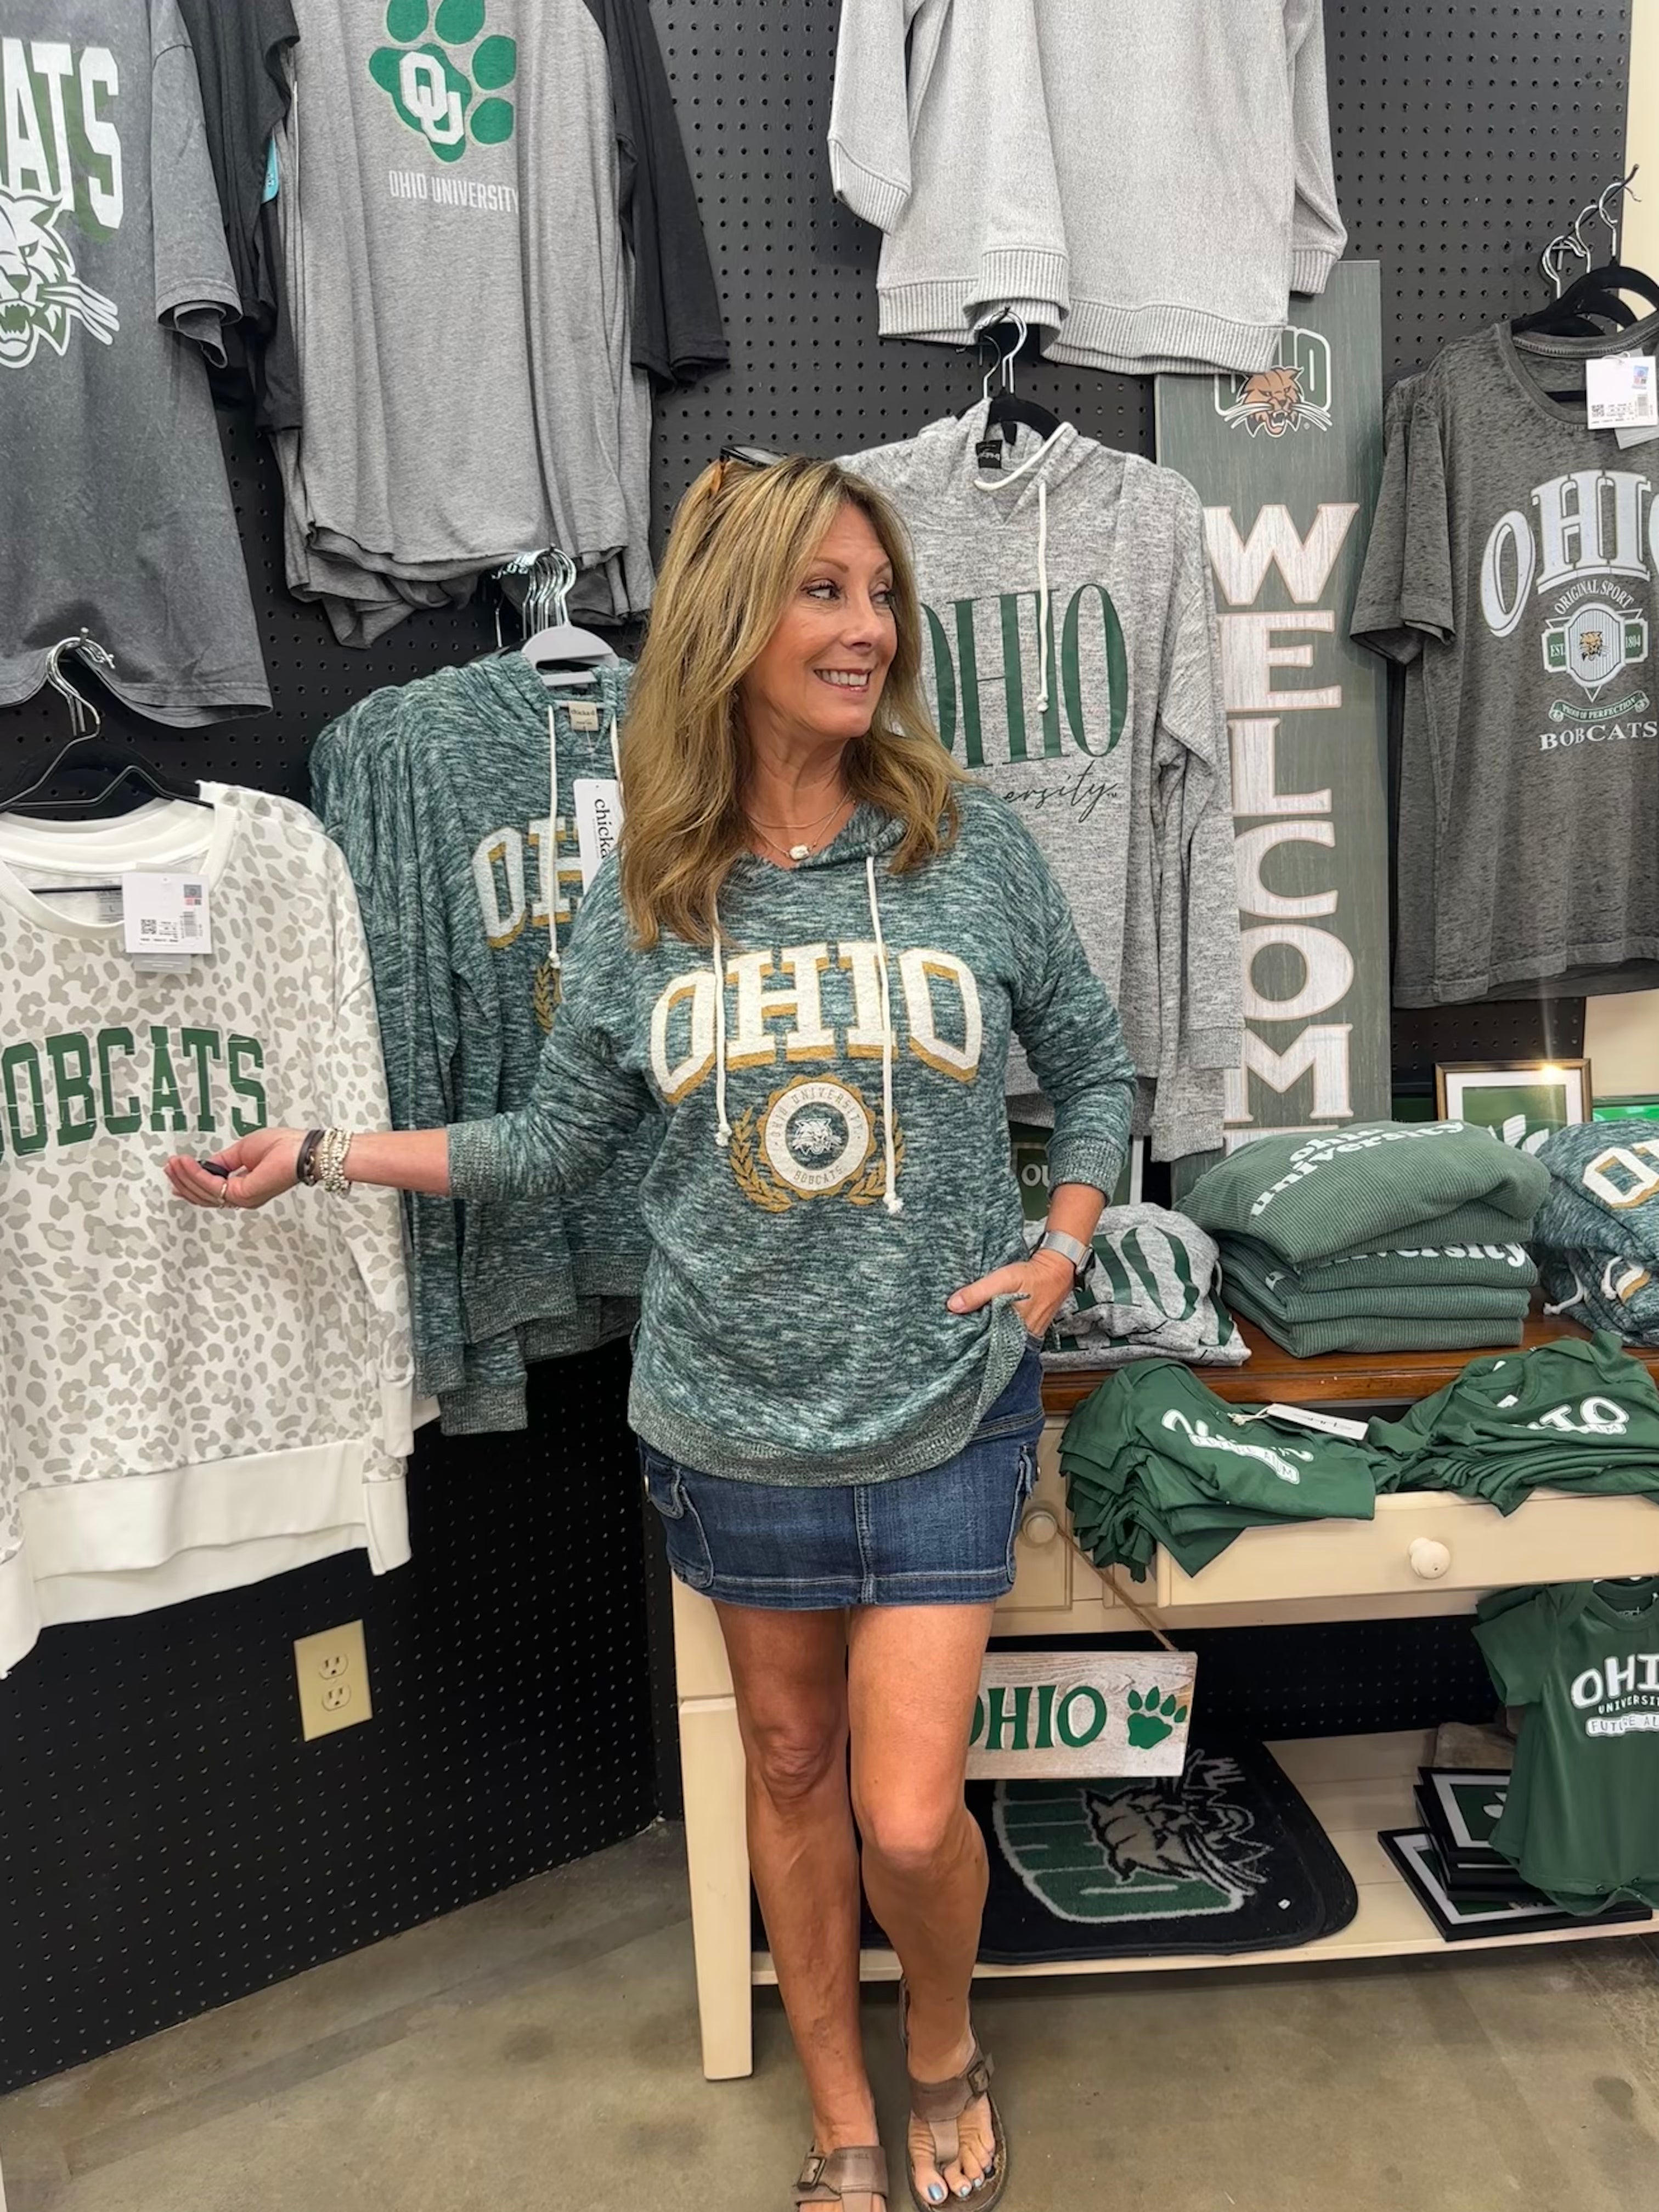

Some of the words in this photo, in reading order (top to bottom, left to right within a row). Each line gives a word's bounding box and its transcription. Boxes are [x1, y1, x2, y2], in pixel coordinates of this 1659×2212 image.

[399, 52, 465, 145] OU
[389, 170, 427, 199] OHIO
[431, 176, 519, 215] UNIVERSITY
[1481, 469, 1659, 637] OHI
[1554, 579, 1599, 615] ORIGINAL
[1600, 580, 1634, 608] SPORT
[1626, 634, 1641, 648] 1804
[1589, 696, 1636, 719] PERFECTION
[1539, 721, 1657, 752] BOBCATS
[1003, 760, 1118, 823] ersity
[1204, 503, 1359, 1152] WELCOM
[651, 940, 983, 1104] OHIO
[0, 1025, 267, 1156] OBCATS
[771, 1107, 788, 1137] OHIO
[792, 1087, 864, 1133] UNIVERSITY
[1250, 1122, 1464, 1216] university
[1289, 1128, 1386, 1163] ohio
[793, 1165, 844, 1185] BOBCATS
